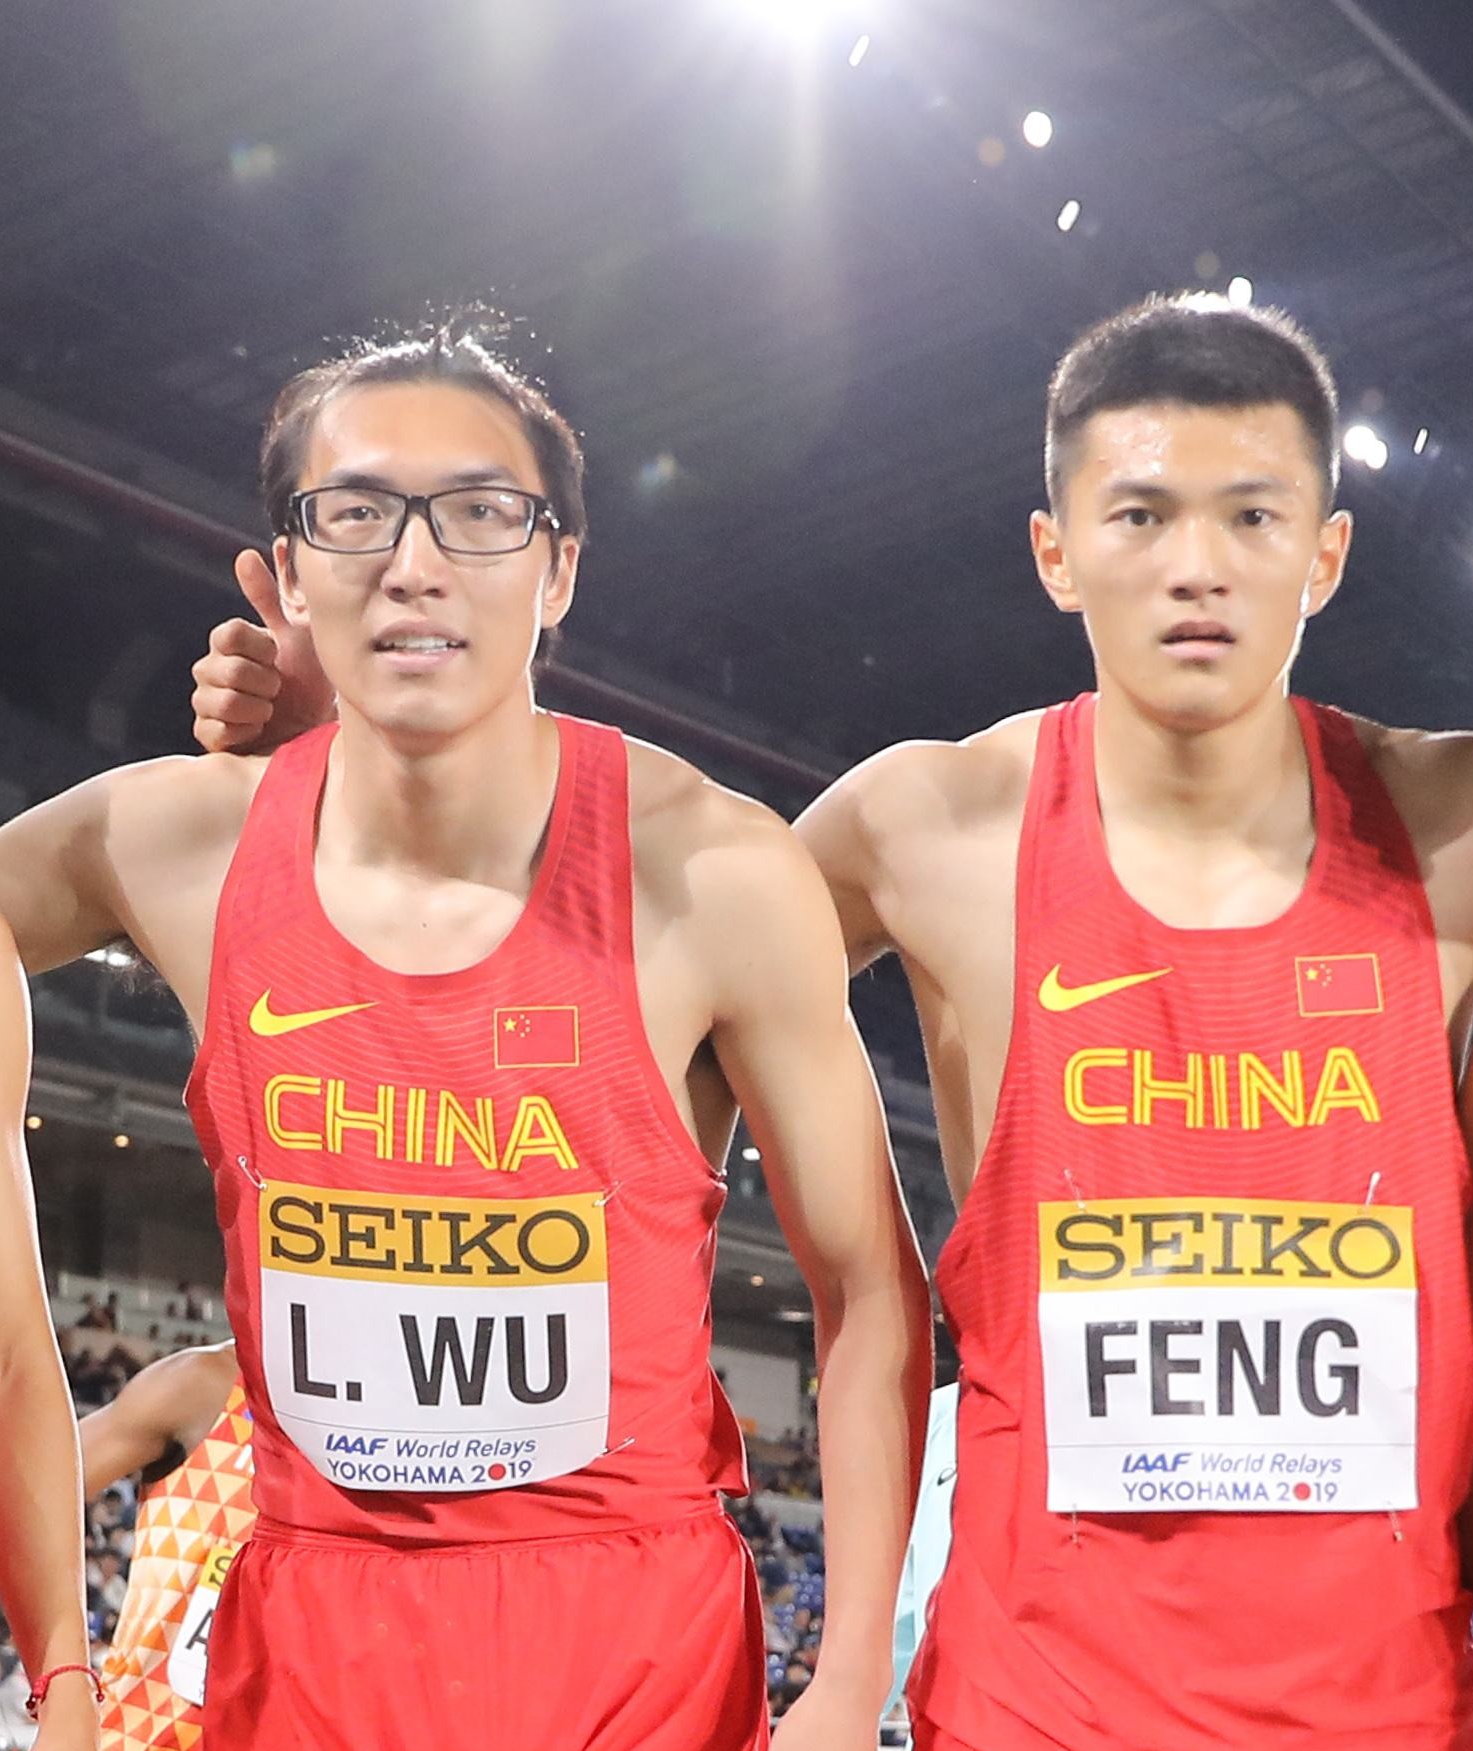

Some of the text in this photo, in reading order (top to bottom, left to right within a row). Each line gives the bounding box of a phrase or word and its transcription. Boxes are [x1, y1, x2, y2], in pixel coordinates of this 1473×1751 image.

[264, 1074, 579, 1172] CHINA
[1064, 1047, 1381, 1130] CHINA
[269, 1196, 590, 1275] SEIKO
[1055, 1212, 1401, 1279] SEIKO
[289, 1303, 568, 1407] L. WU
[1084, 1318, 1360, 1418] FENG
[326, 1433, 536, 1460] IAAF World Relays
[326, 1459, 465, 1484] YOKOHAMA
[1121, 1452, 1343, 1476] IAAF World Relays
[1123, 1482, 1270, 1502] YOKOHAMA
